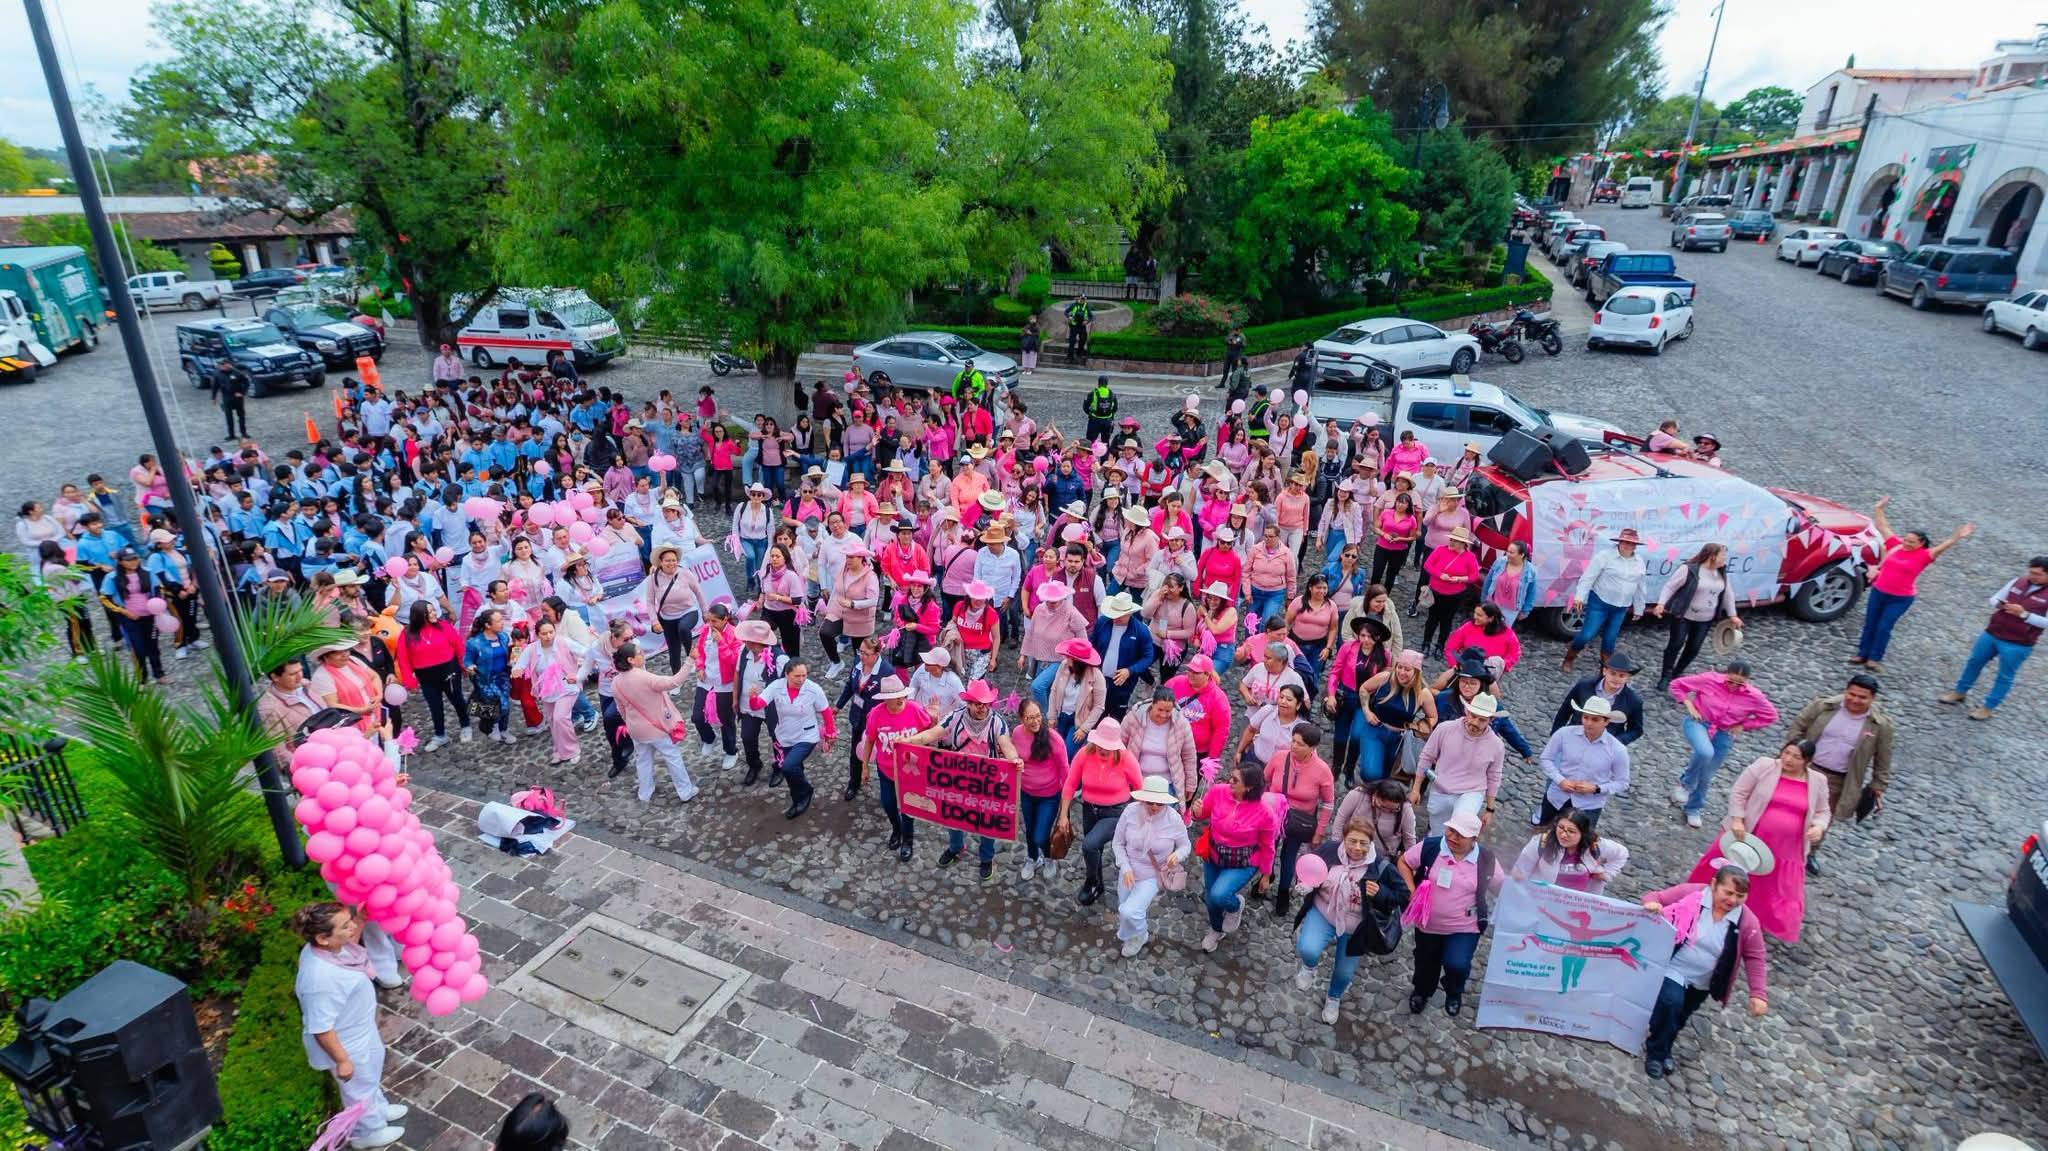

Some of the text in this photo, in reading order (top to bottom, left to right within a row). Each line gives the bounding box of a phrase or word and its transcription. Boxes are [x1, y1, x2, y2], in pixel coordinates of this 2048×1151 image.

[929, 751, 998, 776] Cuidate
[927, 766, 1010, 800] tocate
[941, 799, 1010, 832] toque
[980, 798, 1001, 813] que
